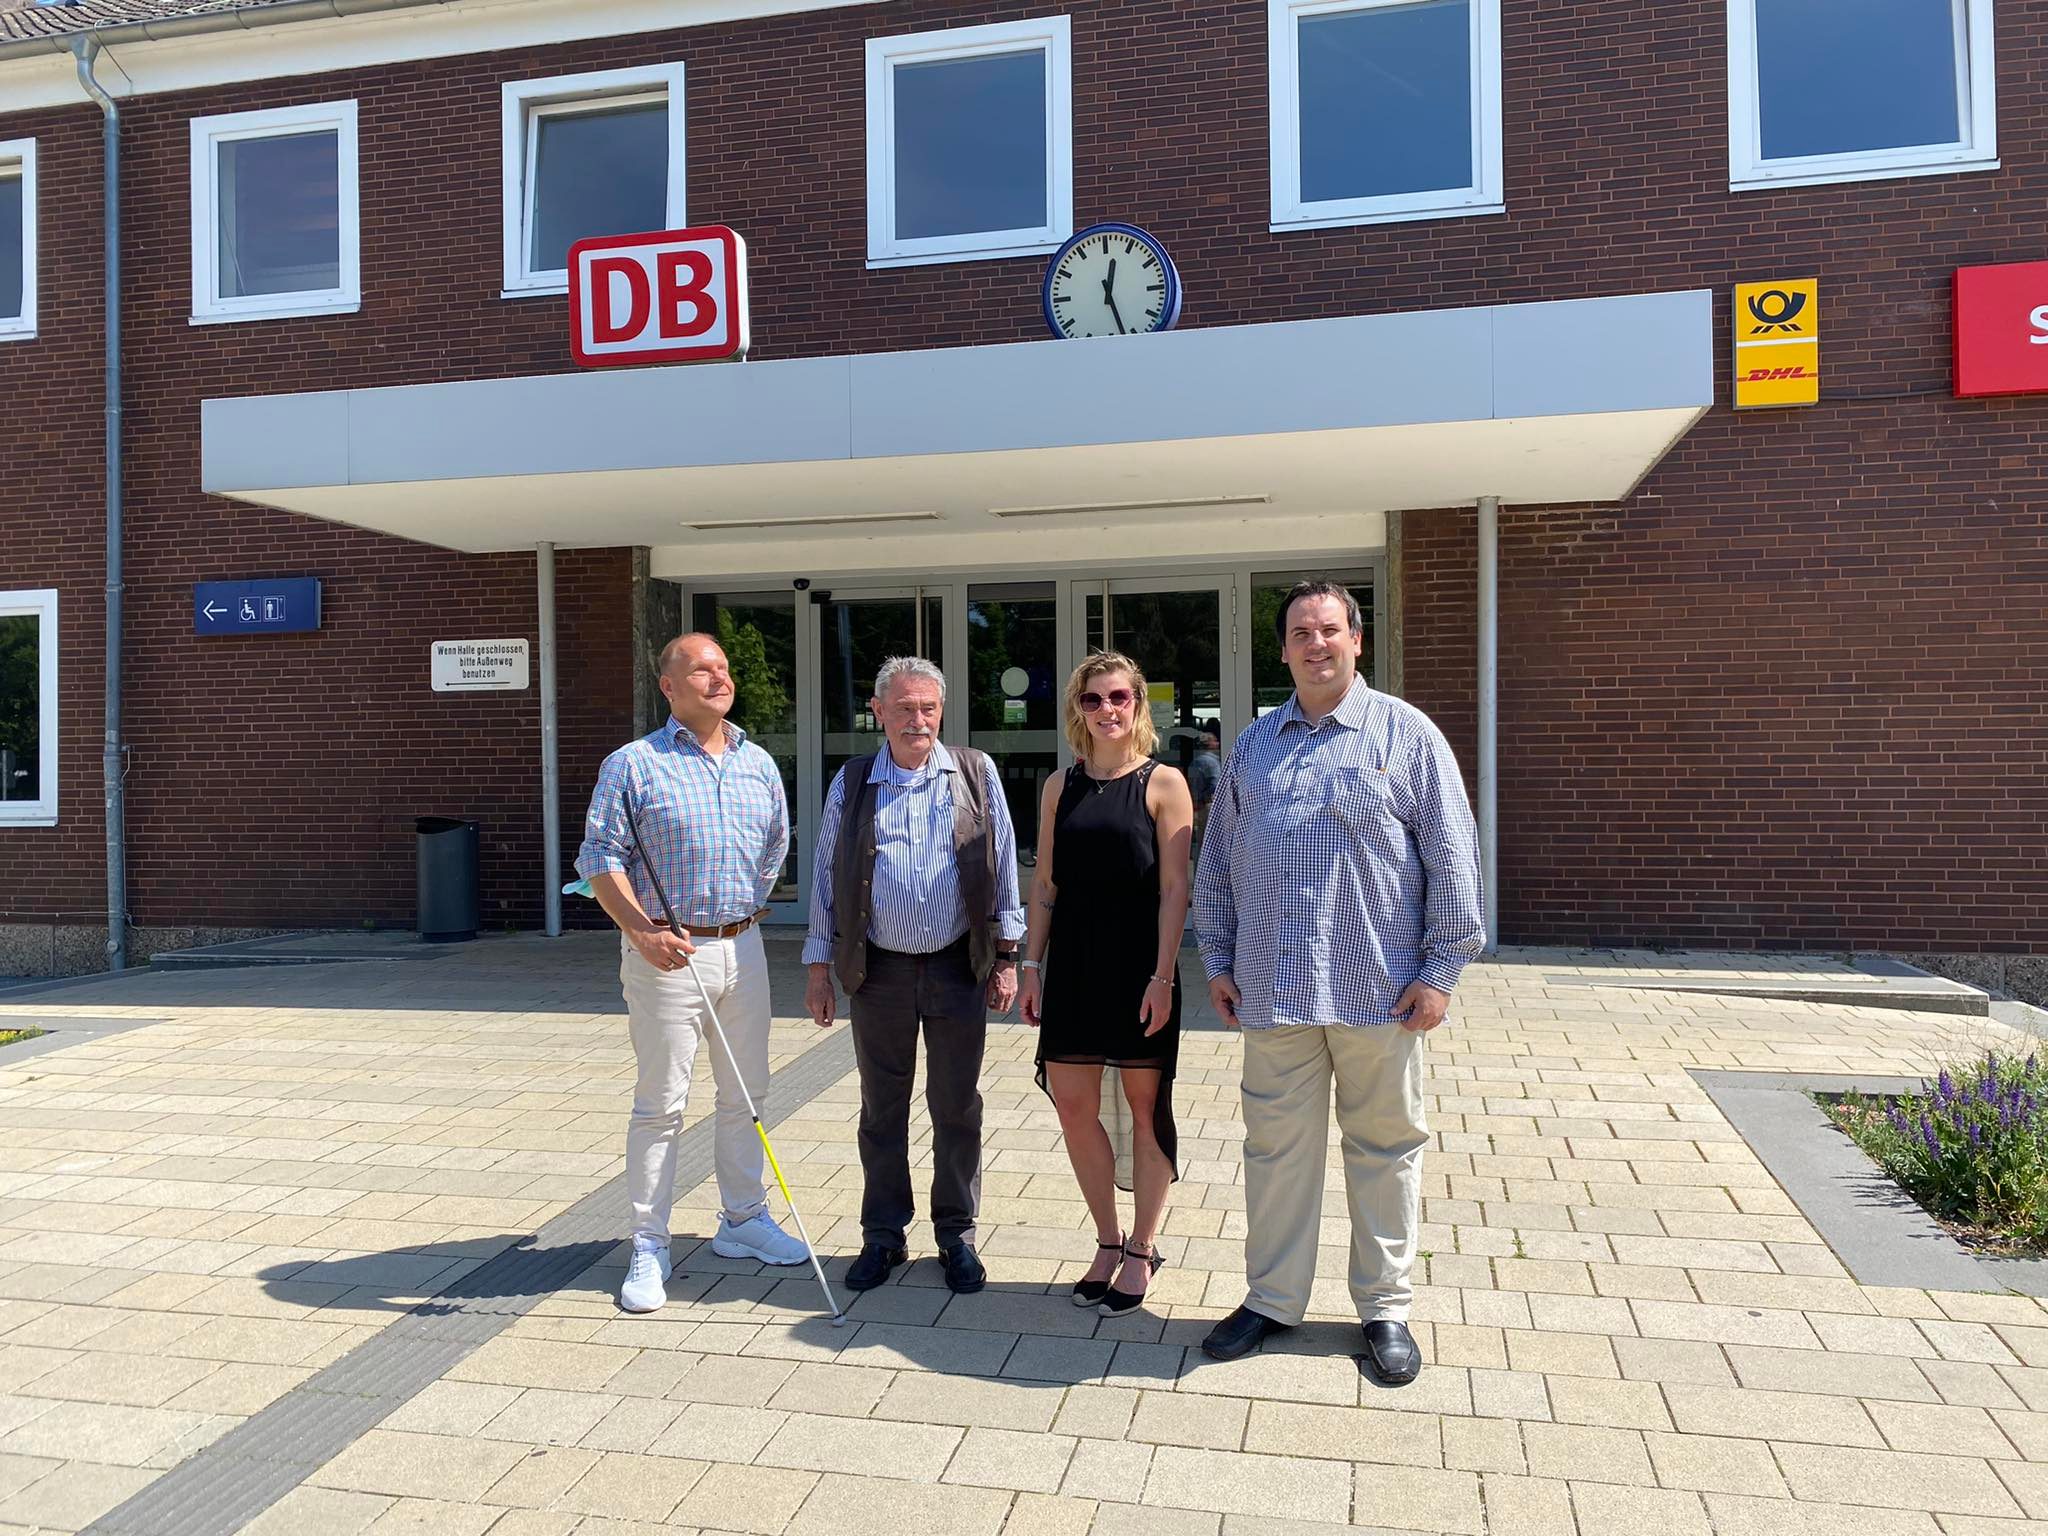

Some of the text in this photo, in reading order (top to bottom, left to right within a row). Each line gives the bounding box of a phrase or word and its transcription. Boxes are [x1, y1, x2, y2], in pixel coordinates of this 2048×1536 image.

[590, 250, 717, 344] DB
[1748, 367, 1807, 381] DHL
[438, 646, 456, 655] Wenn
[458, 645, 475, 654] Halle
[460, 656, 513, 667] bitte Außenweg
[462, 669, 496, 679] benutzen
